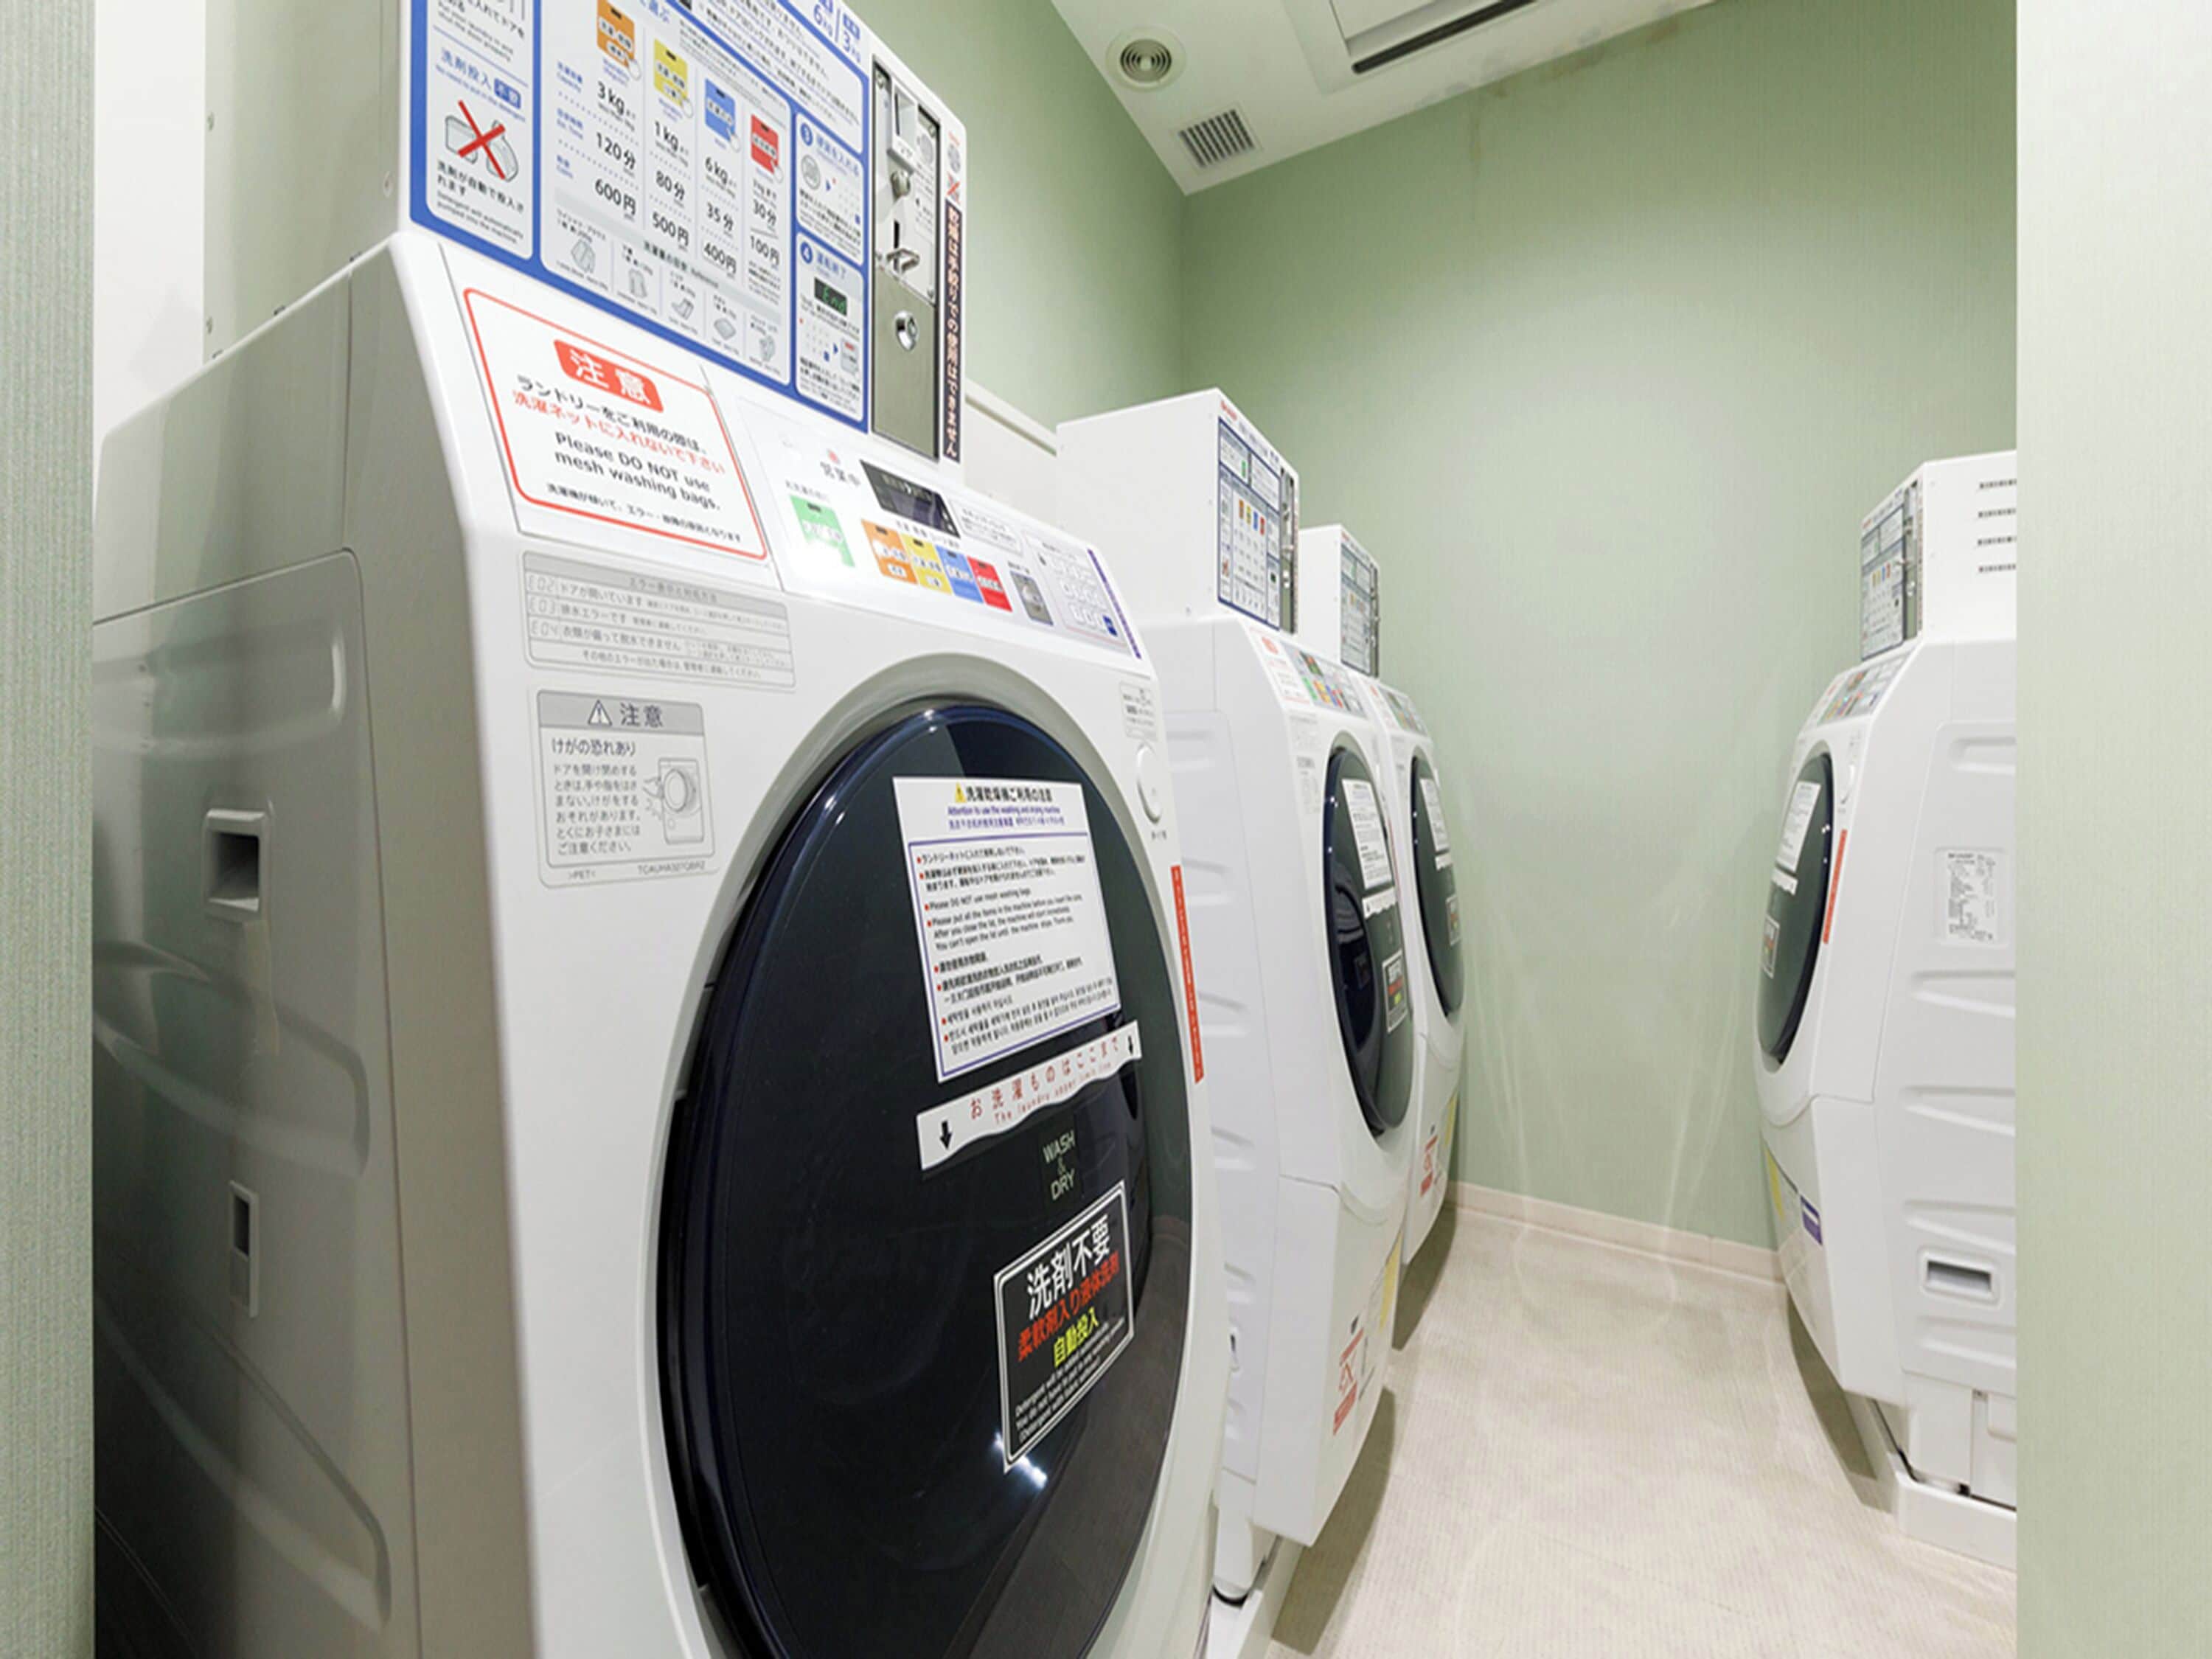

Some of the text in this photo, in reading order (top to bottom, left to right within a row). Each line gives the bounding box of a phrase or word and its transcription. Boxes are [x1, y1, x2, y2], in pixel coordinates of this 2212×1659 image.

[597, 132, 636, 170] 120分
[595, 178, 636, 215] 600円
[655, 170, 685, 201] 80分
[653, 212, 689, 246] 500円
[704, 243, 737, 274] 400円
[570, 349, 652, 405] 注意
[555, 431, 710, 492] Please DO NOT use
[554, 451, 721, 510] mesh washing bags.
[619, 703, 664, 728] 注意
[552, 738, 637, 757] けがの恐れあり
[557, 825, 640, 840] とくにお子さまには
[933, 917, 951, 926] Please
[1043, 1130, 1077, 1164] WASH
[1050, 1168, 1076, 1200] DRY
[1027, 1214, 1110, 1321] 洗剤不要
[1053, 1305, 1099, 1368] 自動投入
